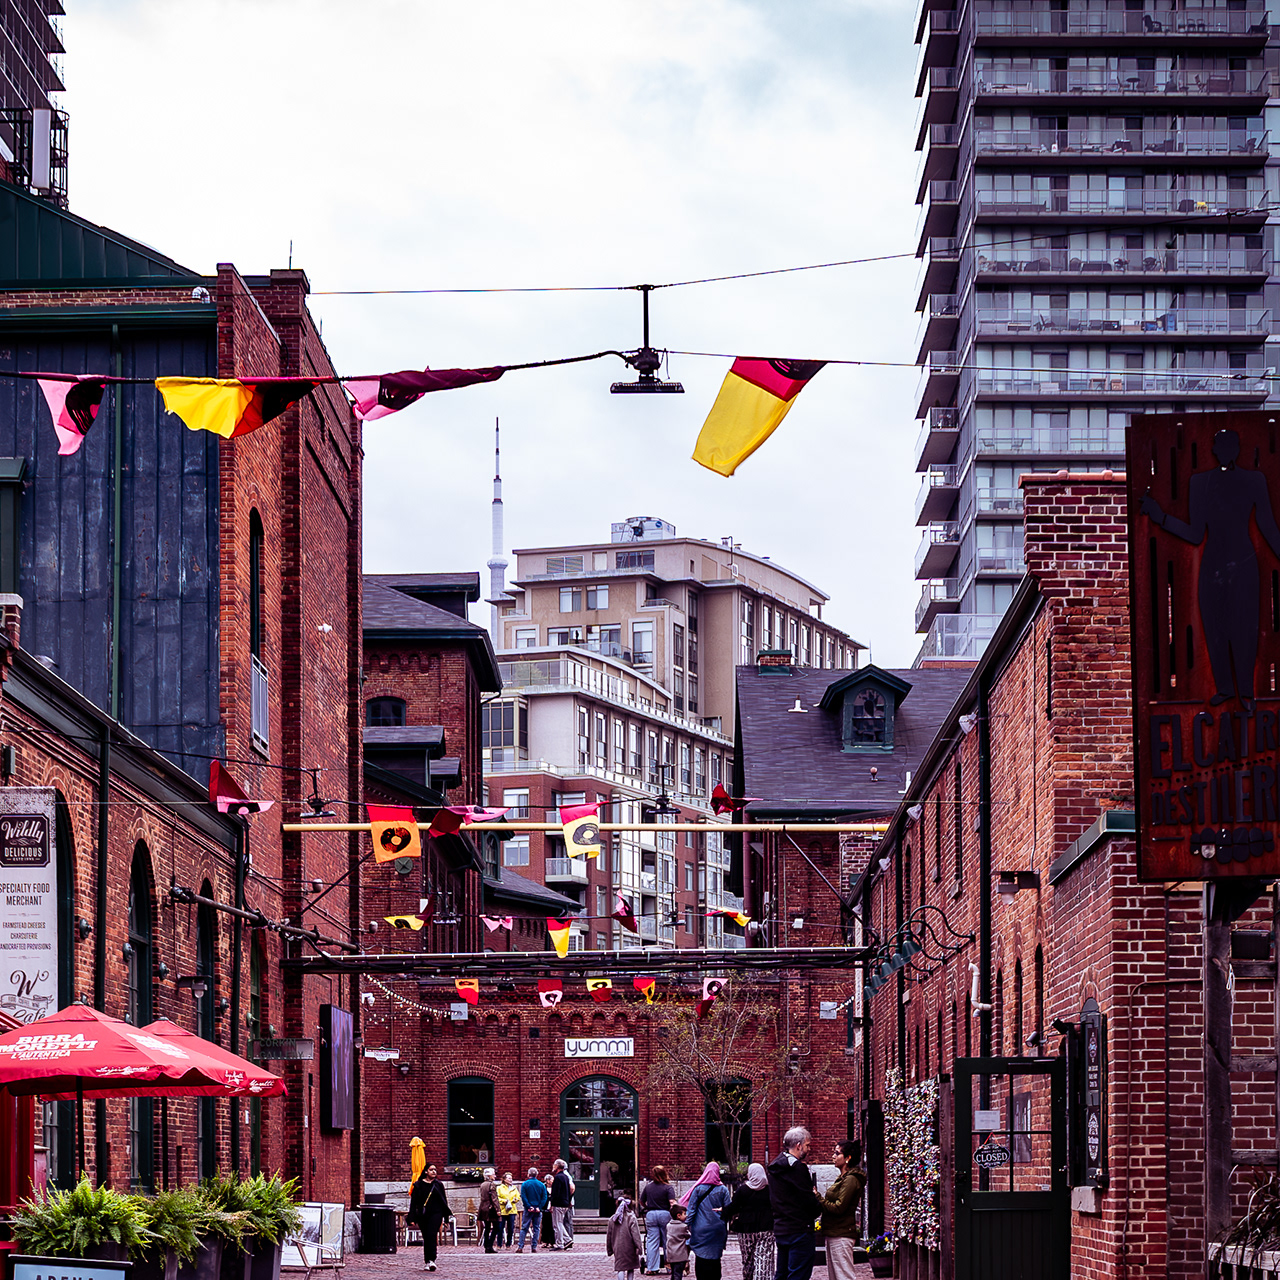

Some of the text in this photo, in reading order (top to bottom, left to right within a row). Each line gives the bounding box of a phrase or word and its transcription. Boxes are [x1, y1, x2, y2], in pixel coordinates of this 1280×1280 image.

[1150, 713, 1193, 779] EL
[1, 820, 44, 844] Wildly
[4, 847, 43, 857] DELICIOUS
[32, 883, 50, 893] FOOD
[6, 895, 42, 906] MERCHANT
[27, 921, 46, 929] CHEESES
[15, 1033, 85, 1045] BIRRA
[259, 1038, 297, 1048] CORKIN
[259, 1050, 304, 1059] GALLERY
[975, 1152, 1008, 1163] CLOSED
